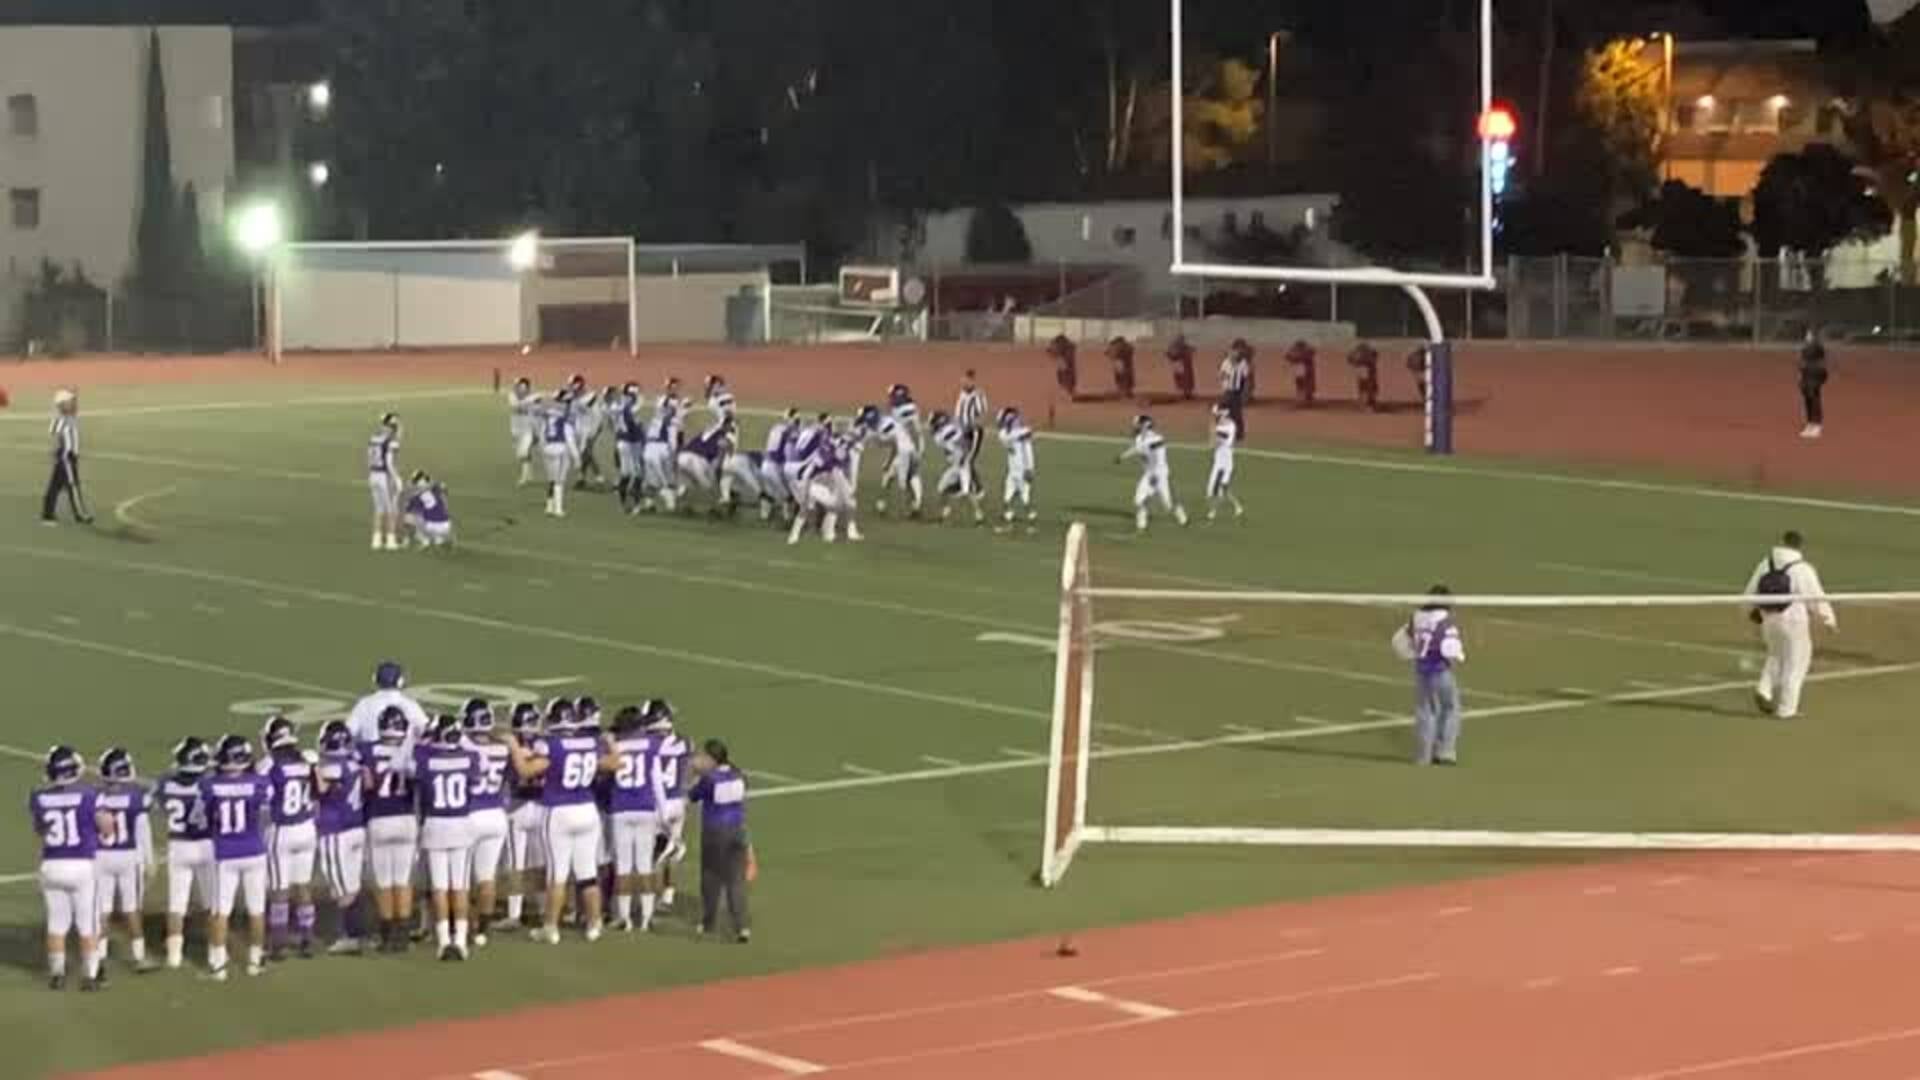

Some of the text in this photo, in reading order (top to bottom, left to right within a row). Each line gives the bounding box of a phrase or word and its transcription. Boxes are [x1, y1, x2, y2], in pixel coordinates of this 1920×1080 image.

[562, 752, 597, 789] 68
[615, 753, 646, 788] 21
[433, 772, 467, 808] 10
[44, 809, 80, 847] 31
[166, 799, 208, 832] 24
[220, 799, 245, 834] 11
